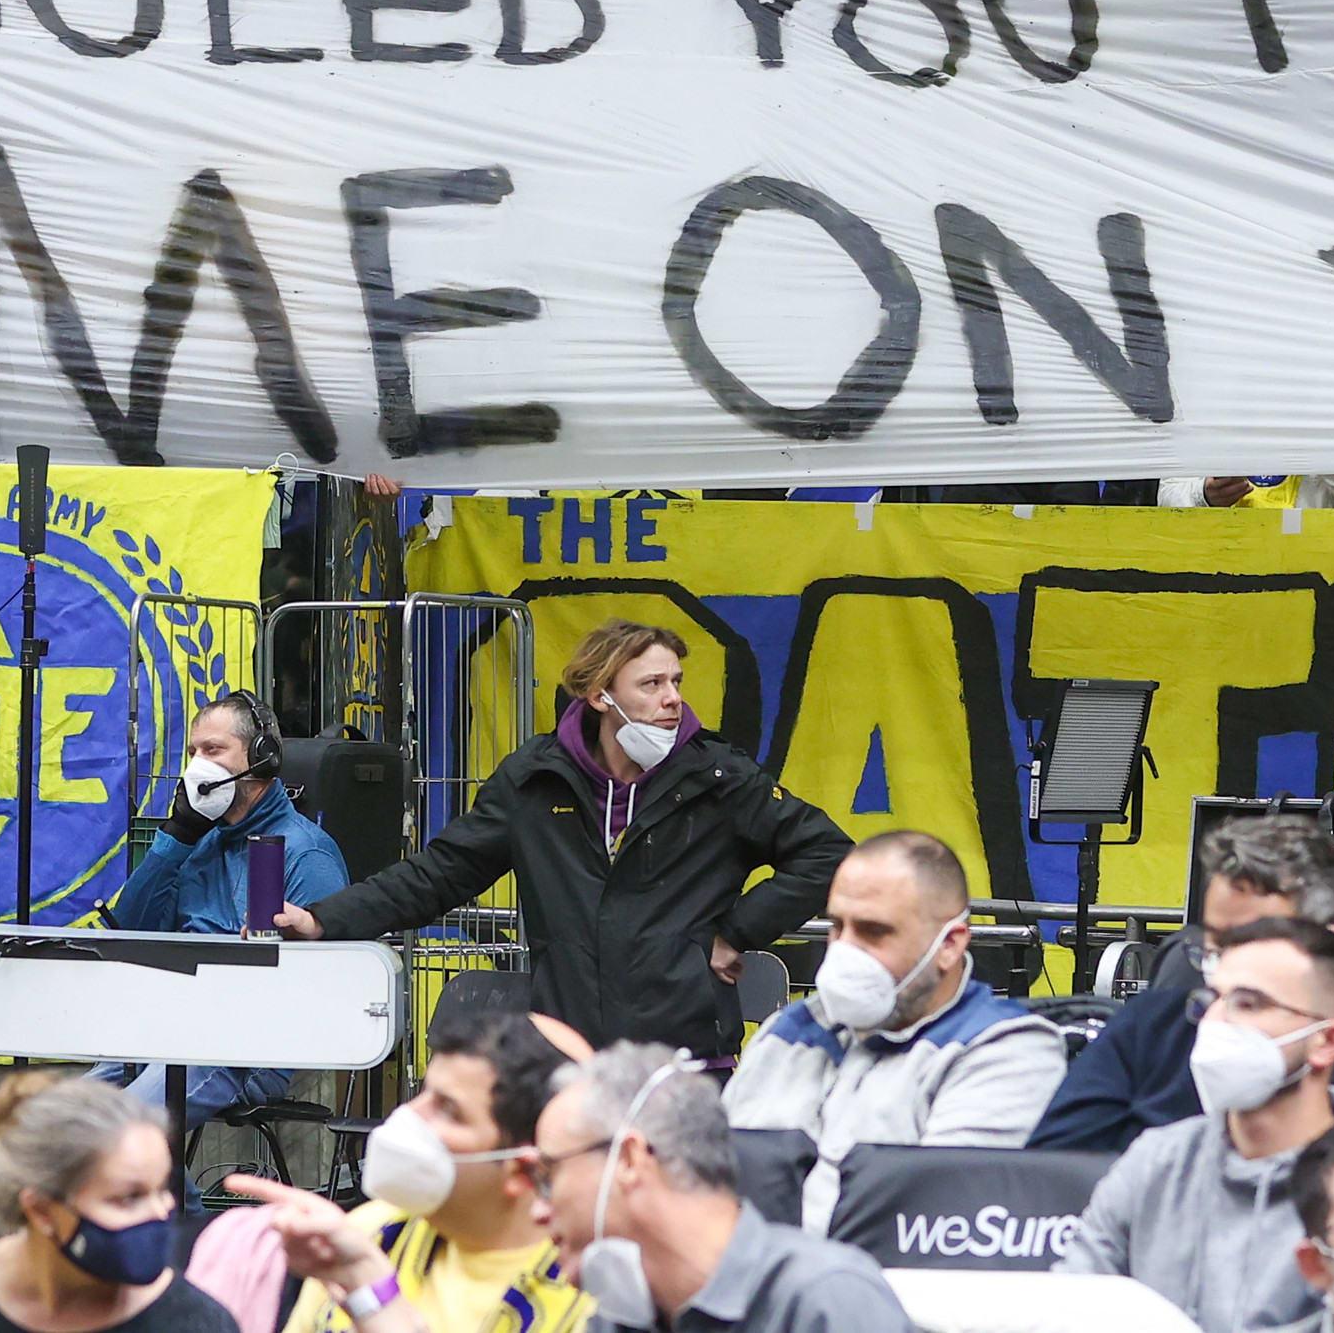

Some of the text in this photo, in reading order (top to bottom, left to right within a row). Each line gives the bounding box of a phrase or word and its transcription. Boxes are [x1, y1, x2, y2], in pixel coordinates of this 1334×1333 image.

[662, 174, 1174, 440] ON
[507, 498, 668, 564] THE
[895, 1204, 1084, 1259] weSure
